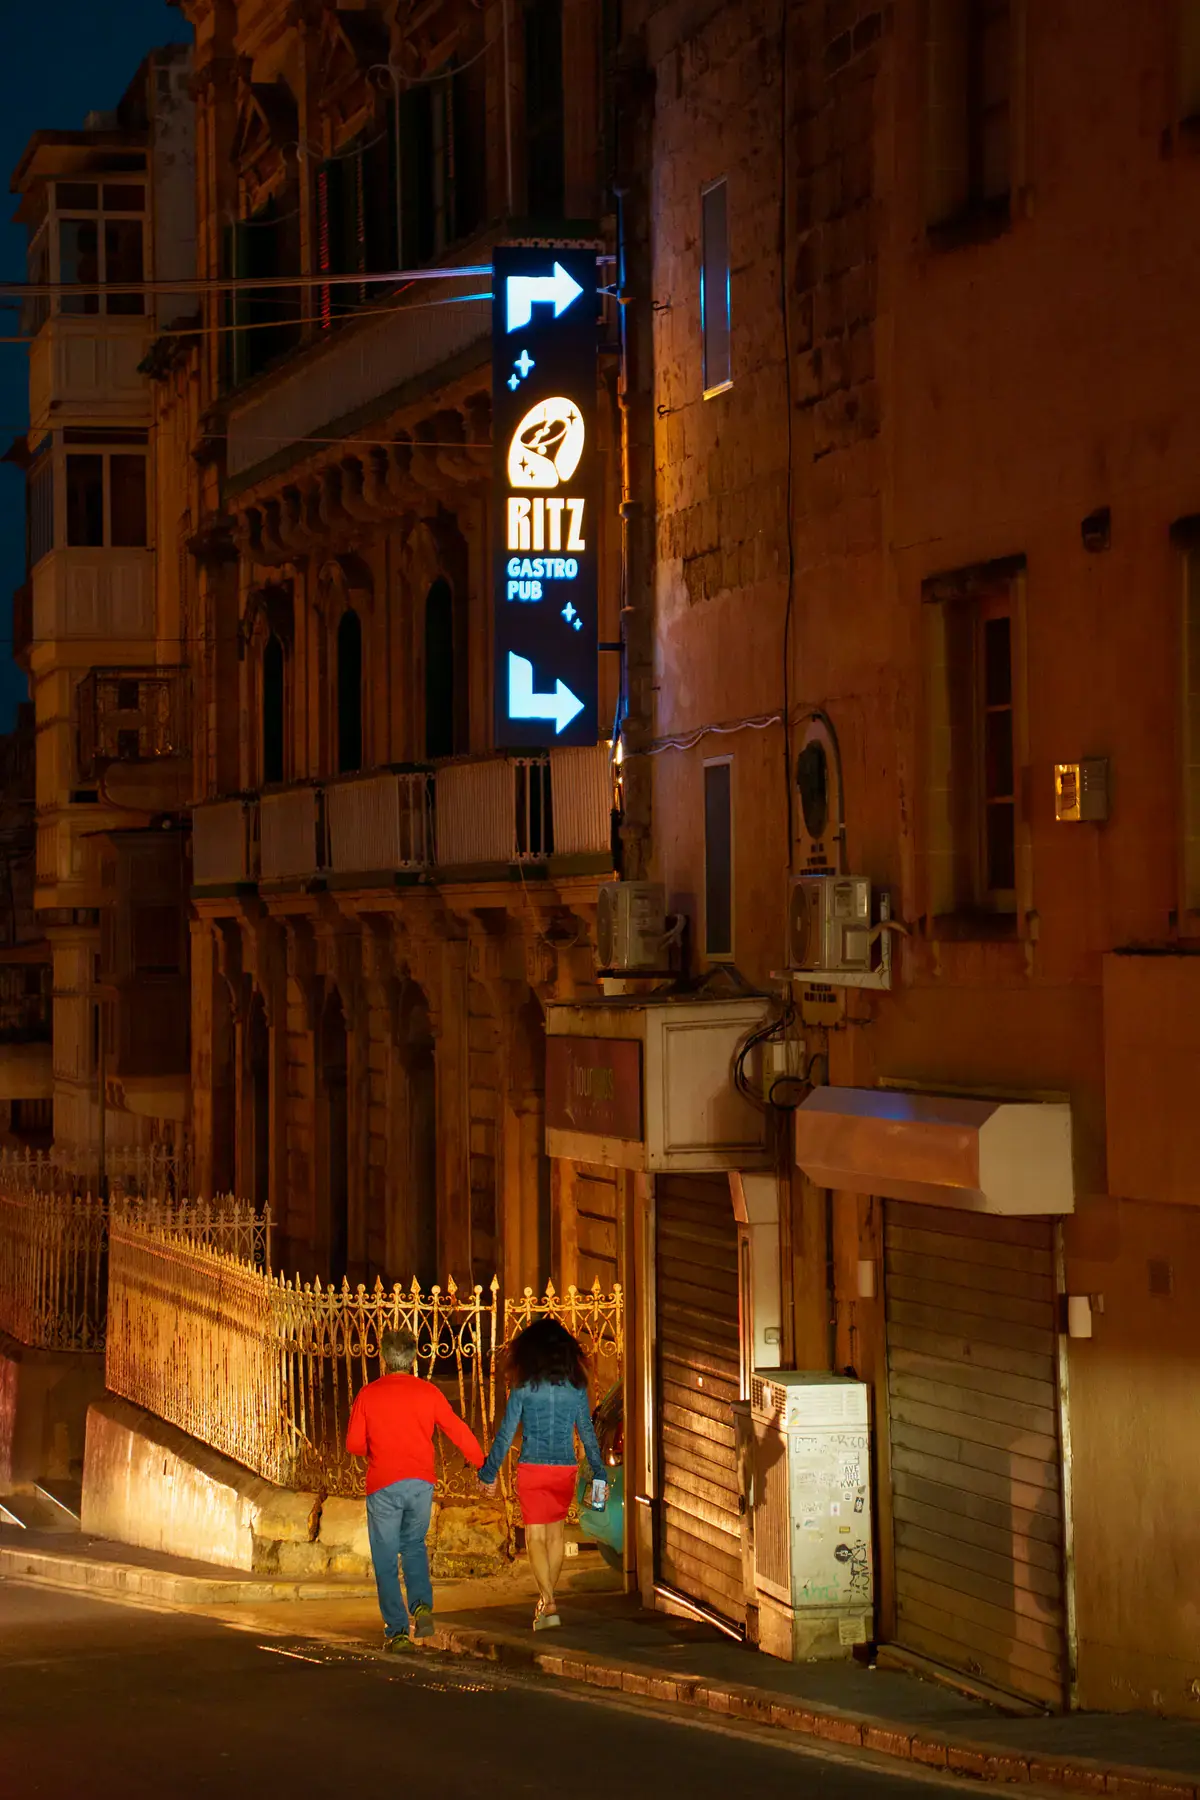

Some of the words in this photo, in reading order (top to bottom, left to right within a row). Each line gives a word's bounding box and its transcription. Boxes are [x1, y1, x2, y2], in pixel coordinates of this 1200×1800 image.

[507, 497, 585, 551] RITZ
[507, 557, 578, 579] GASTRO
[507, 580, 543, 600] PUB
